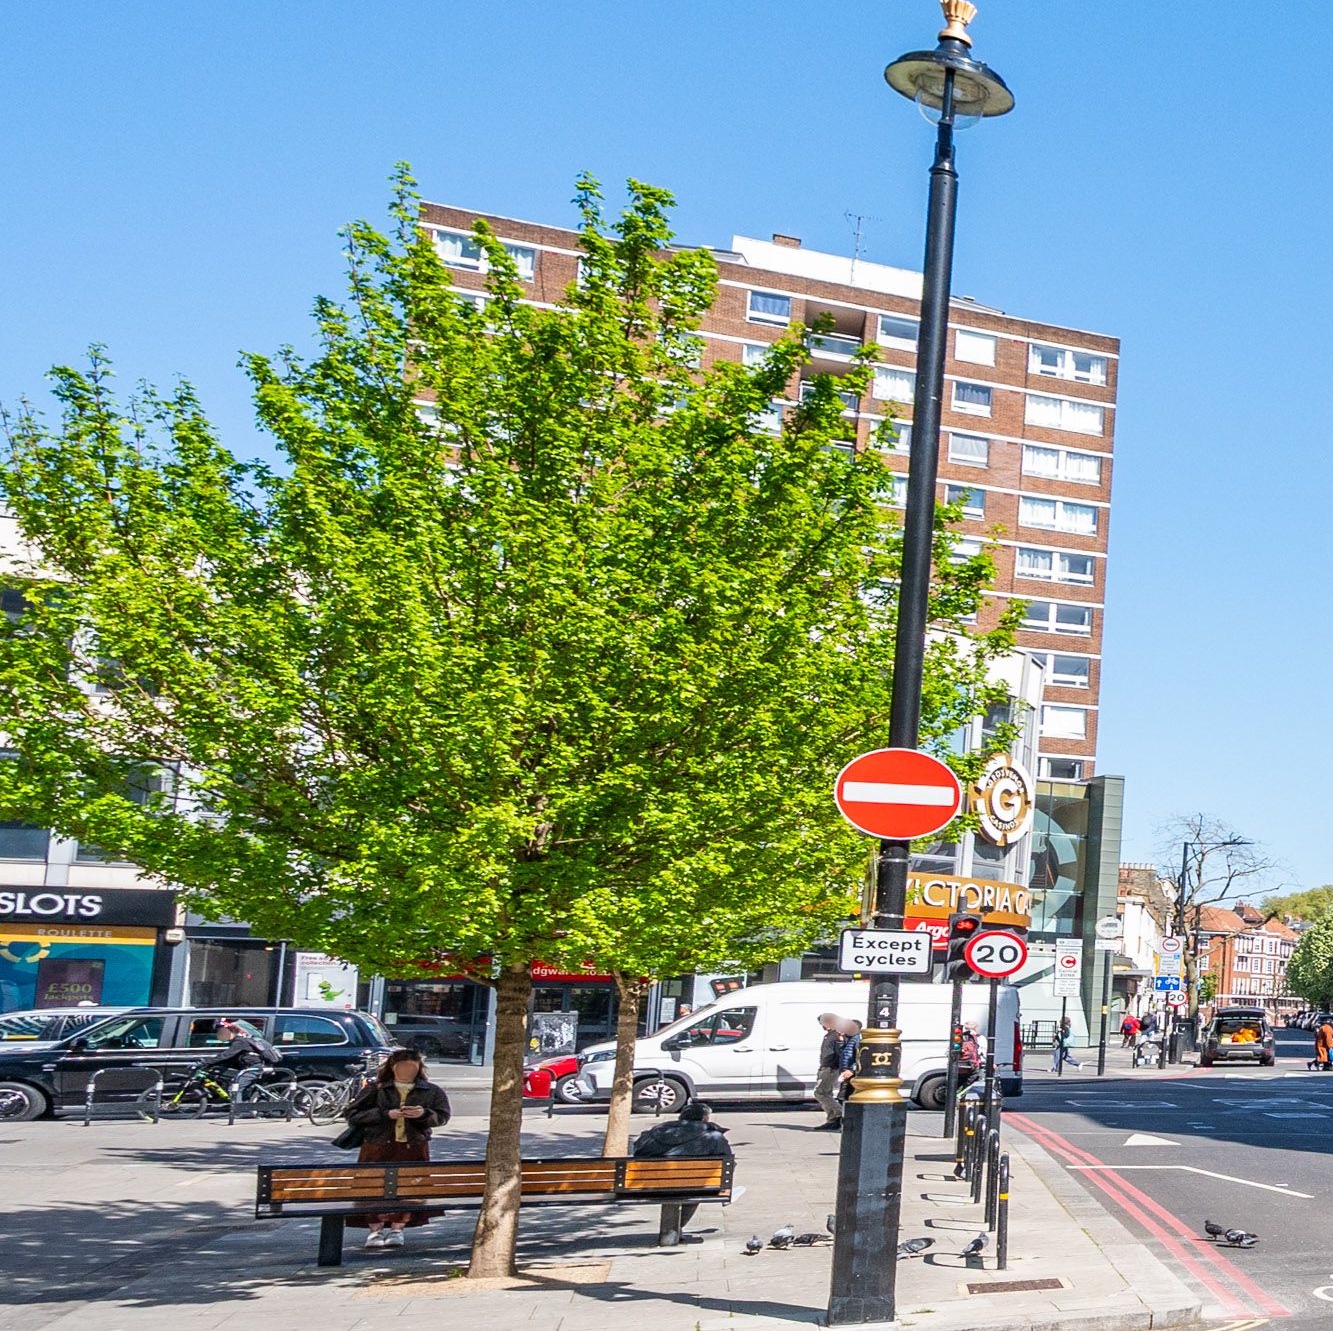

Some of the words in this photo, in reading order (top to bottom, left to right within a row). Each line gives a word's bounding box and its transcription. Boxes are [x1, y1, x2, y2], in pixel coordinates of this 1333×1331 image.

[991, 779, 1022, 822] G
[0, 892, 103, 917] SLOTS
[37, 929, 113, 938] ROULETTE
[915, 921, 949, 940] Argo
[852, 937, 922, 953] Except
[854, 954, 917, 966] cycles
[976, 944, 1019, 964] 20
[47, 983, 93, 994] £500
[1169, 993, 1185, 1002] 20
[880, 1007, 890, 1017] 4
